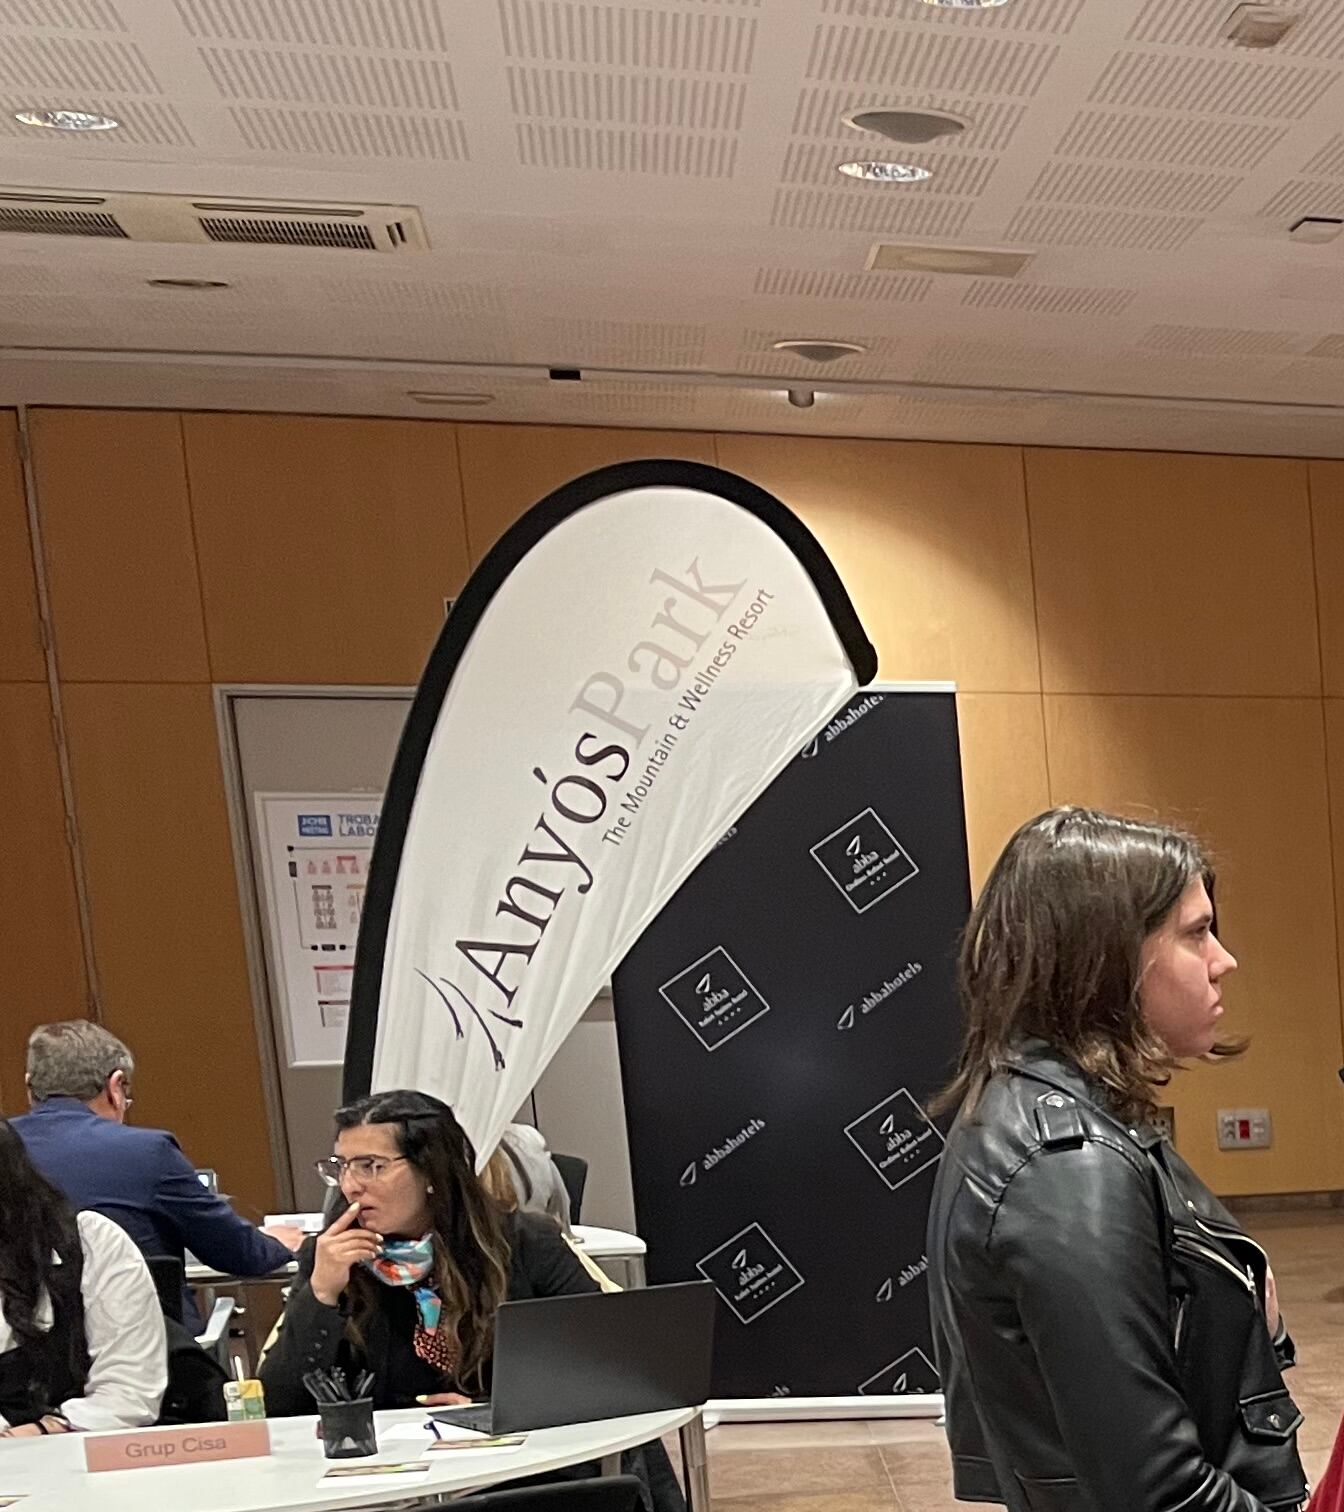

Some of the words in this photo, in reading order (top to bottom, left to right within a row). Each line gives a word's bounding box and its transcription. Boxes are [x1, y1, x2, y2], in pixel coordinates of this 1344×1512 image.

[602, 816, 631, 846] The
[621, 732, 679, 813] Mountain
[678, 641, 737, 712] Wellness
[727, 588, 775, 640] Resort
[125, 1442, 175, 1459] Grup
[182, 1437, 226, 1453] Cisa
